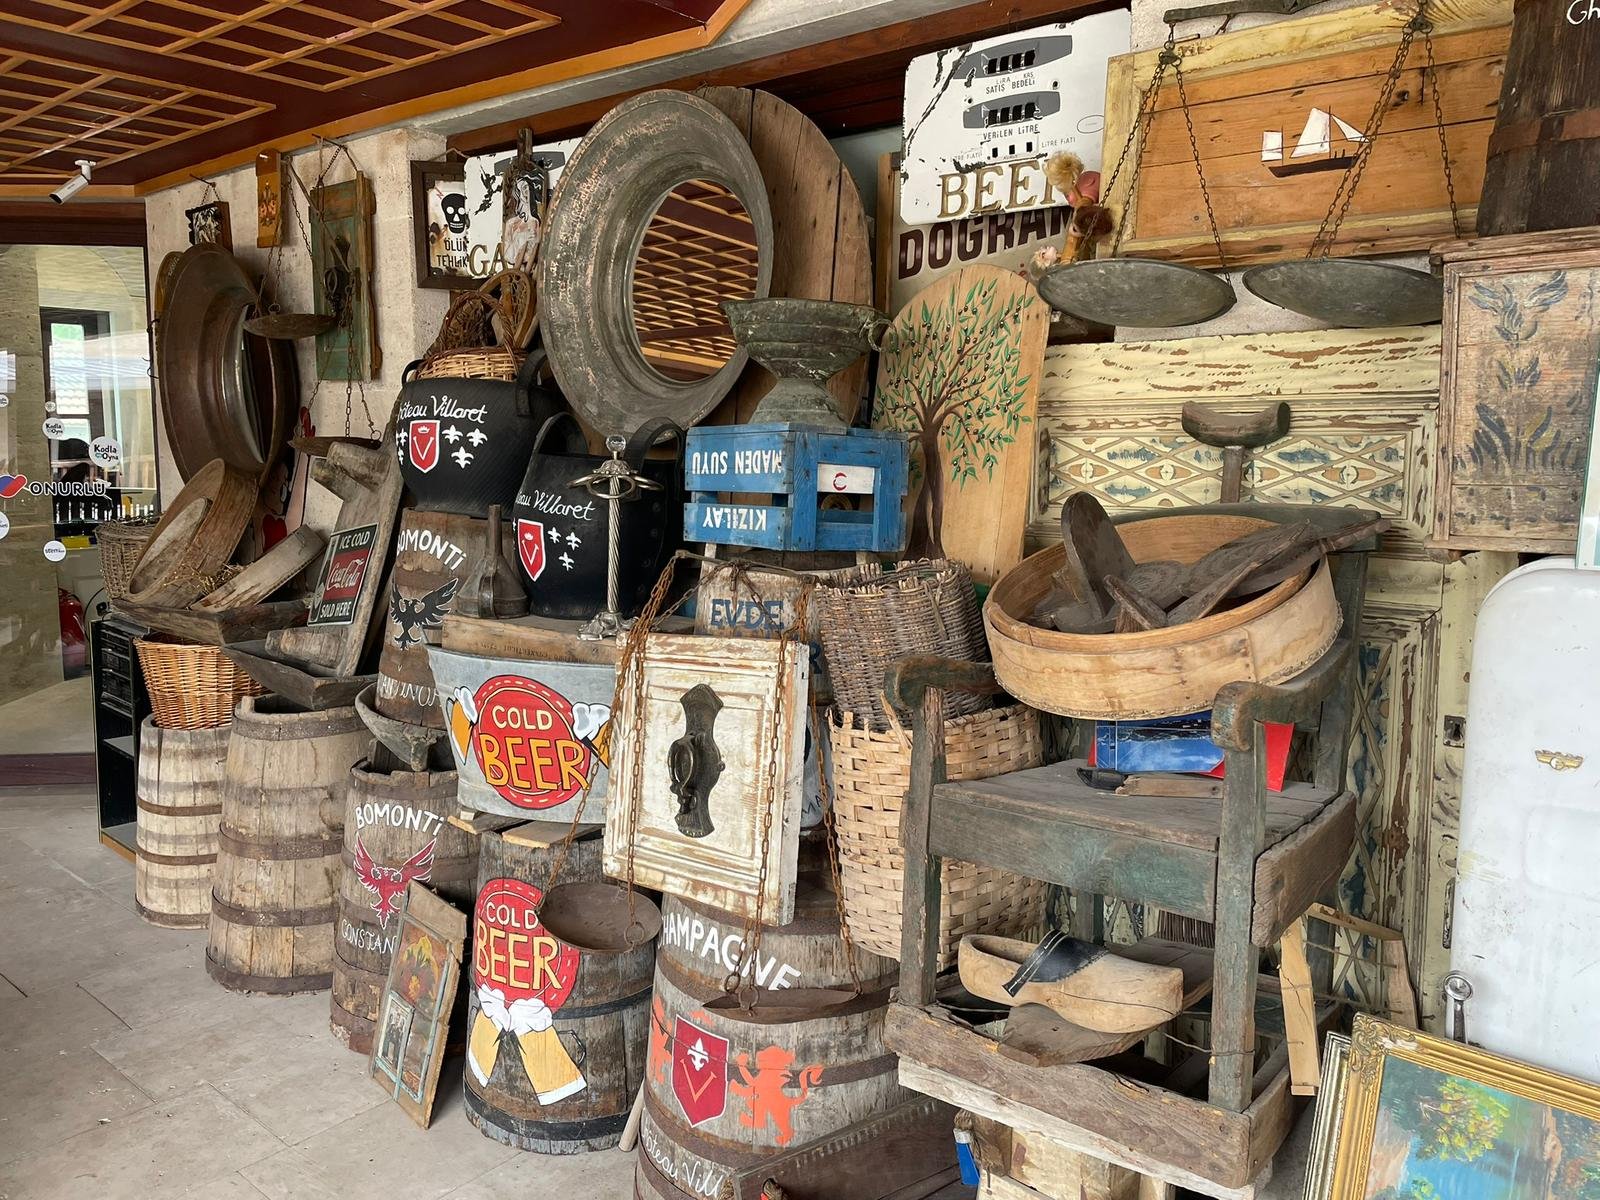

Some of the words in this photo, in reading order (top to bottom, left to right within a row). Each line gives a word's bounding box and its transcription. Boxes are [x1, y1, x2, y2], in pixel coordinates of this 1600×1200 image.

[430, 395, 488, 424] Villaret
[94, 444, 117, 453] Kodla
[692, 451, 728, 474] SUYU
[734, 449, 782, 474] MADEN
[30, 481, 106, 497] ONURLU
[533, 490, 596, 520] Villaret
[702, 507, 767, 531] KIZILAY
[351, 531, 370, 547] COLD
[320, 604, 335, 619] SOLD
[335, 601, 352, 616] HERE
[711, 598, 785, 629] EVDE
[491, 705, 553, 730] COLD
[479, 733, 590, 791] BEER
[486, 901, 539, 930] COLD
[476, 917, 562, 990] BEER
[658, 912, 802, 991] HAMPAGNE
